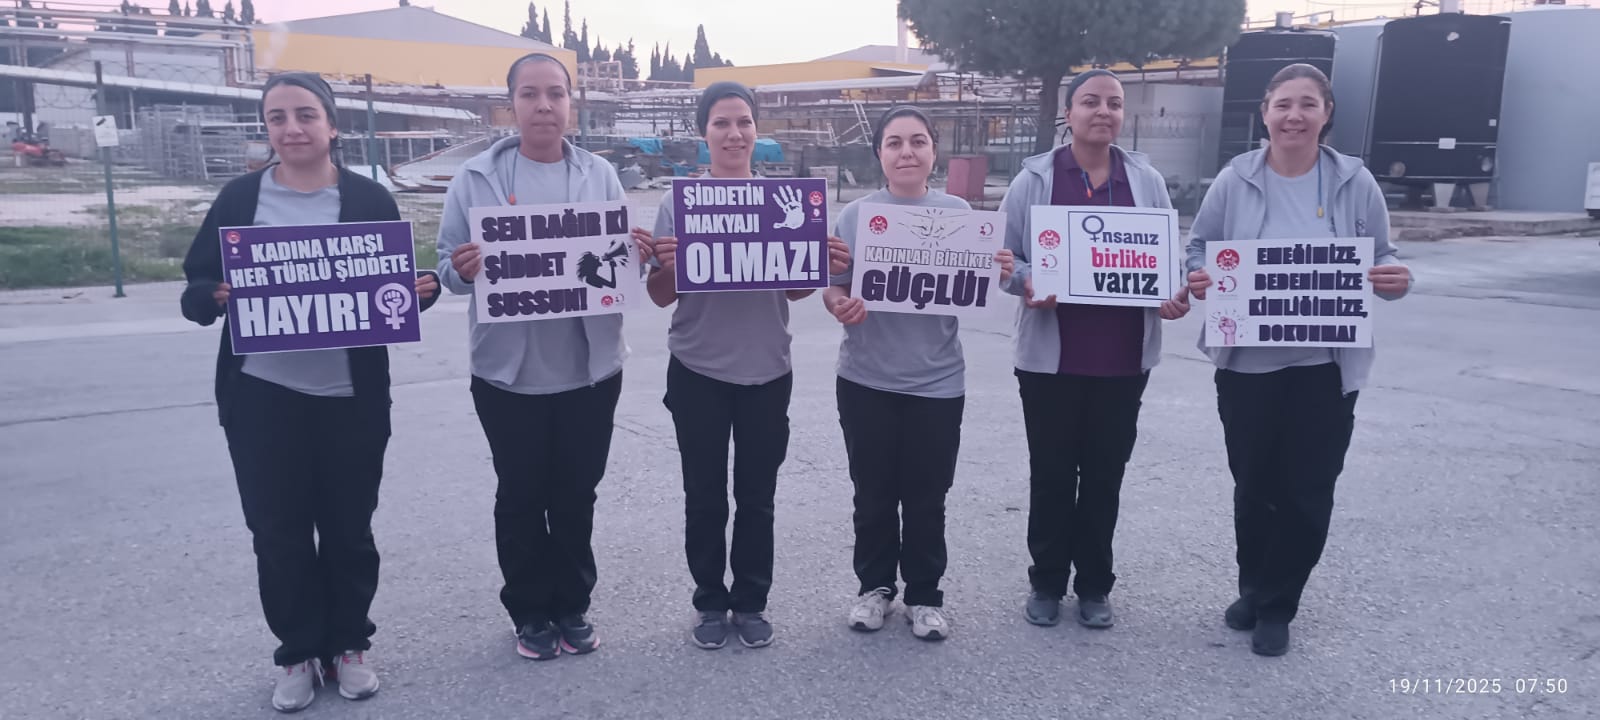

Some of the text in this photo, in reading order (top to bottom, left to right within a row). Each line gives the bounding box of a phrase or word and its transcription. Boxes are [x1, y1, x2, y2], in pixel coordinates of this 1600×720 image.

[683, 183, 765, 209] ŞİDDETİN
[481, 205, 629, 242] SEN BAĞIR Kİ
[684, 214, 760, 234] MAKYAJI
[251, 233, 384, 263] KADINA KARŞI
[865, 245, 993, 269] KADINLAR BİRLİKTE
[1091, 247, 1157, 269] birlikte
[1257, 243, 1361, 266] EMEĞİMİZE,
[229, 253, 411, 289] HER TÜRLÜ ŞİDDETE
[484, 250, 567, 285] ŞİDDET
[685, 241, 820, 284] OLMAZ!
[861, 266, 990, 310] GÜÇLÜ!
[1093, 272, 1159, 296] varız
[236, 291, 371, 338] HAYIR!
[487, 287, 588, 317] SUSSUN!
[1249, 296, 1368, 318] KİMLİĞİMİZE,
[1258, 324, 1357, 342] DOKUNMA!
